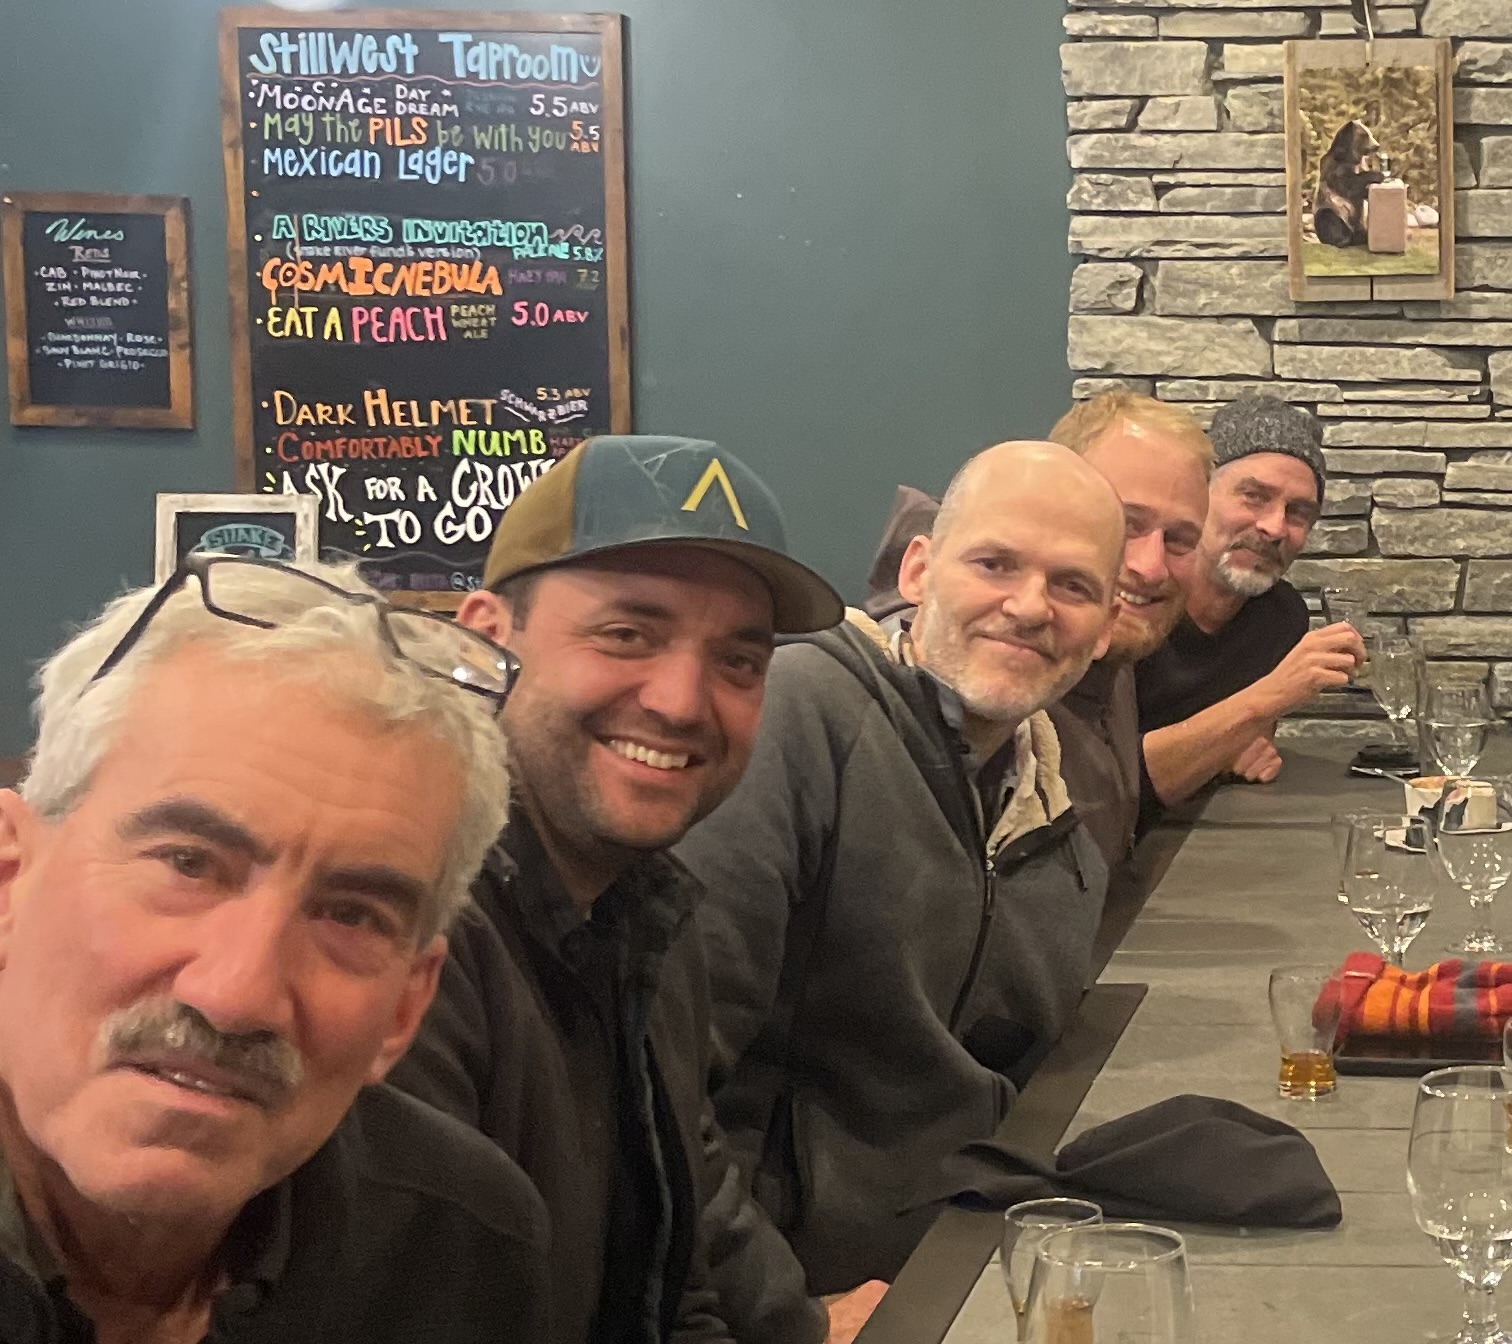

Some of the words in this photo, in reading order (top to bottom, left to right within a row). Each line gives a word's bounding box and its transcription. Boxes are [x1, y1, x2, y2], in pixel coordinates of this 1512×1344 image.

[256, 83, 388, 115] MOONAGE
[395, 83, 432, 103] DAY
[530, 94, 568, 117] 5.5
[569, 102, 599, 116] ABV
[395, 101, 460, 118] DREAM
[264, 112, 314, 146] May
[320, 112, 363, 144] the
[368, 116, 429, 147] PILS
[437, 119, 464, 148] be
[527, 125, 566, 154] you
[569, 141, 600, 153] ABV
[398, 146, 475, 184] Lager
[45, 218, 125, 243] Wines
[272, 214, 297, 240] A
[40, 265, 67, 279] CAB
[267, 306, 319, 339] EAT
[323, 306, 344, 342] A
[352, 306, 448, 344] PEACH
[511, 301, 551, 327] 5.0
[552, 309, 590, 324] ABV
[273, 390, 357, 426] DARK
[363, 388, 499, 427] HELMET
[277, 431, 444, 463] COMFORTABLY
[452, 428, 547, 457] NUMB
[364, 476, 406, 502] FOR
[417, 474, 439, 503] A
[363, 506, 423, 549] TO
[433, 500, 494, 545] GO
